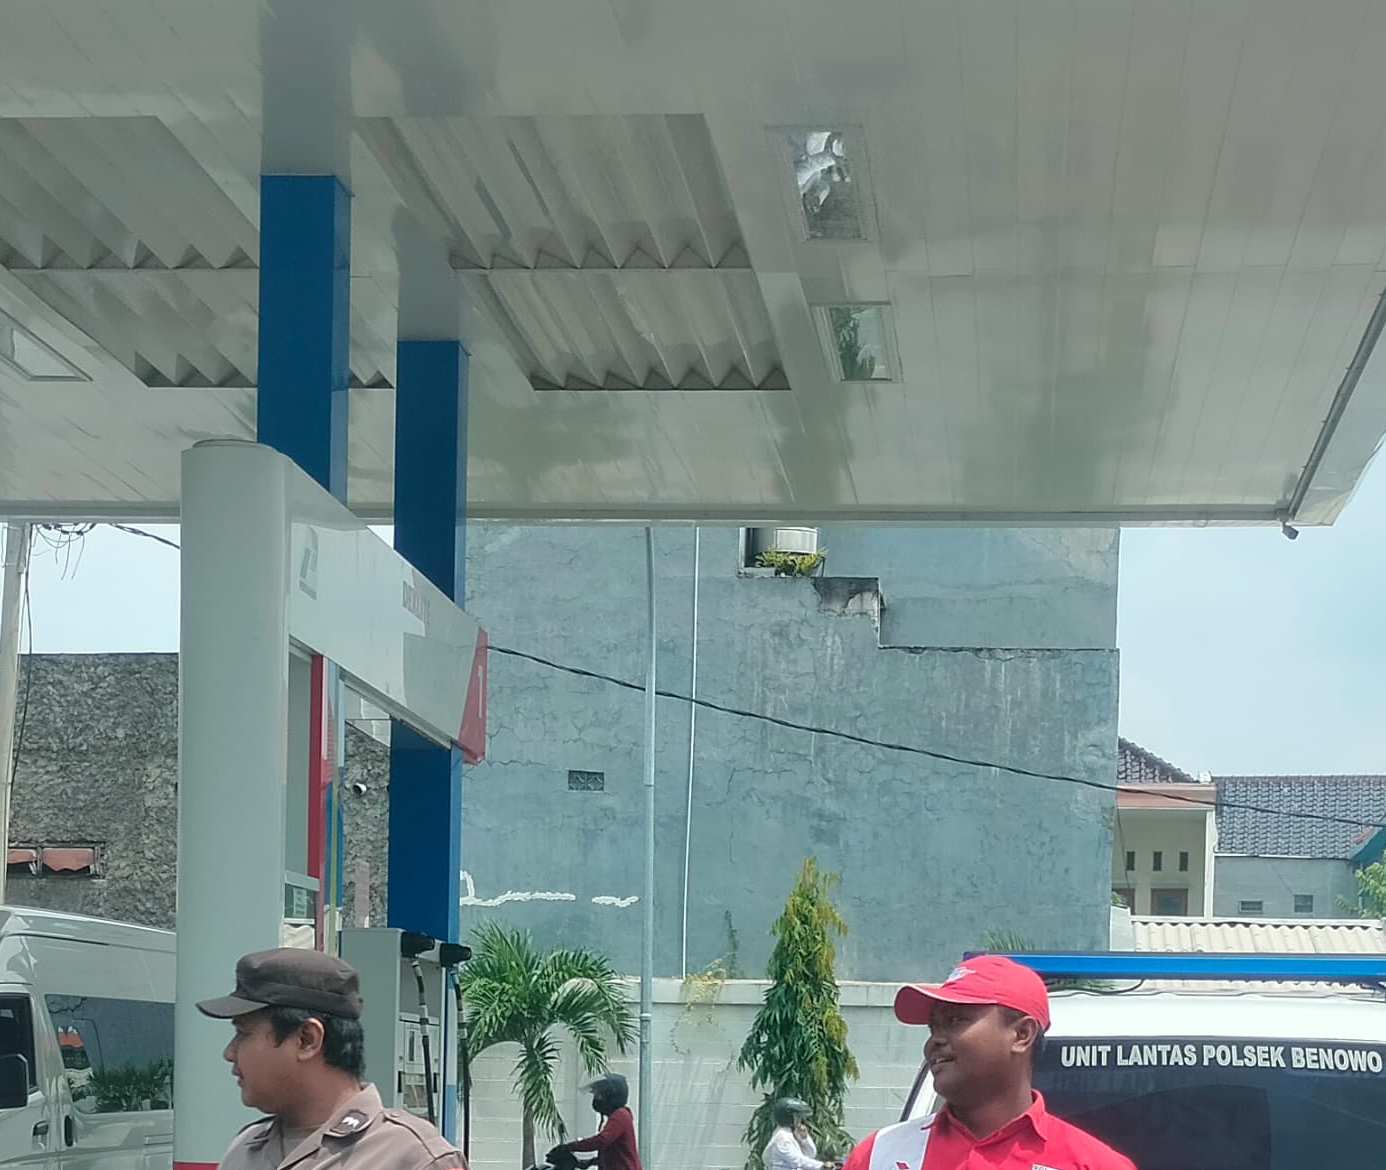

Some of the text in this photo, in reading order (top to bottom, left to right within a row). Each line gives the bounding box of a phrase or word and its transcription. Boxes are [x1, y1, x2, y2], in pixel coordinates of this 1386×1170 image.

[1060, 1045, 1111, 1067] UNIT
[1116, 1044, 1197, 1067] LANTAS
[1203, 1045, 1285, 1068] POLSEK
[1291, 1047, 1383, 1073] BENOWO
